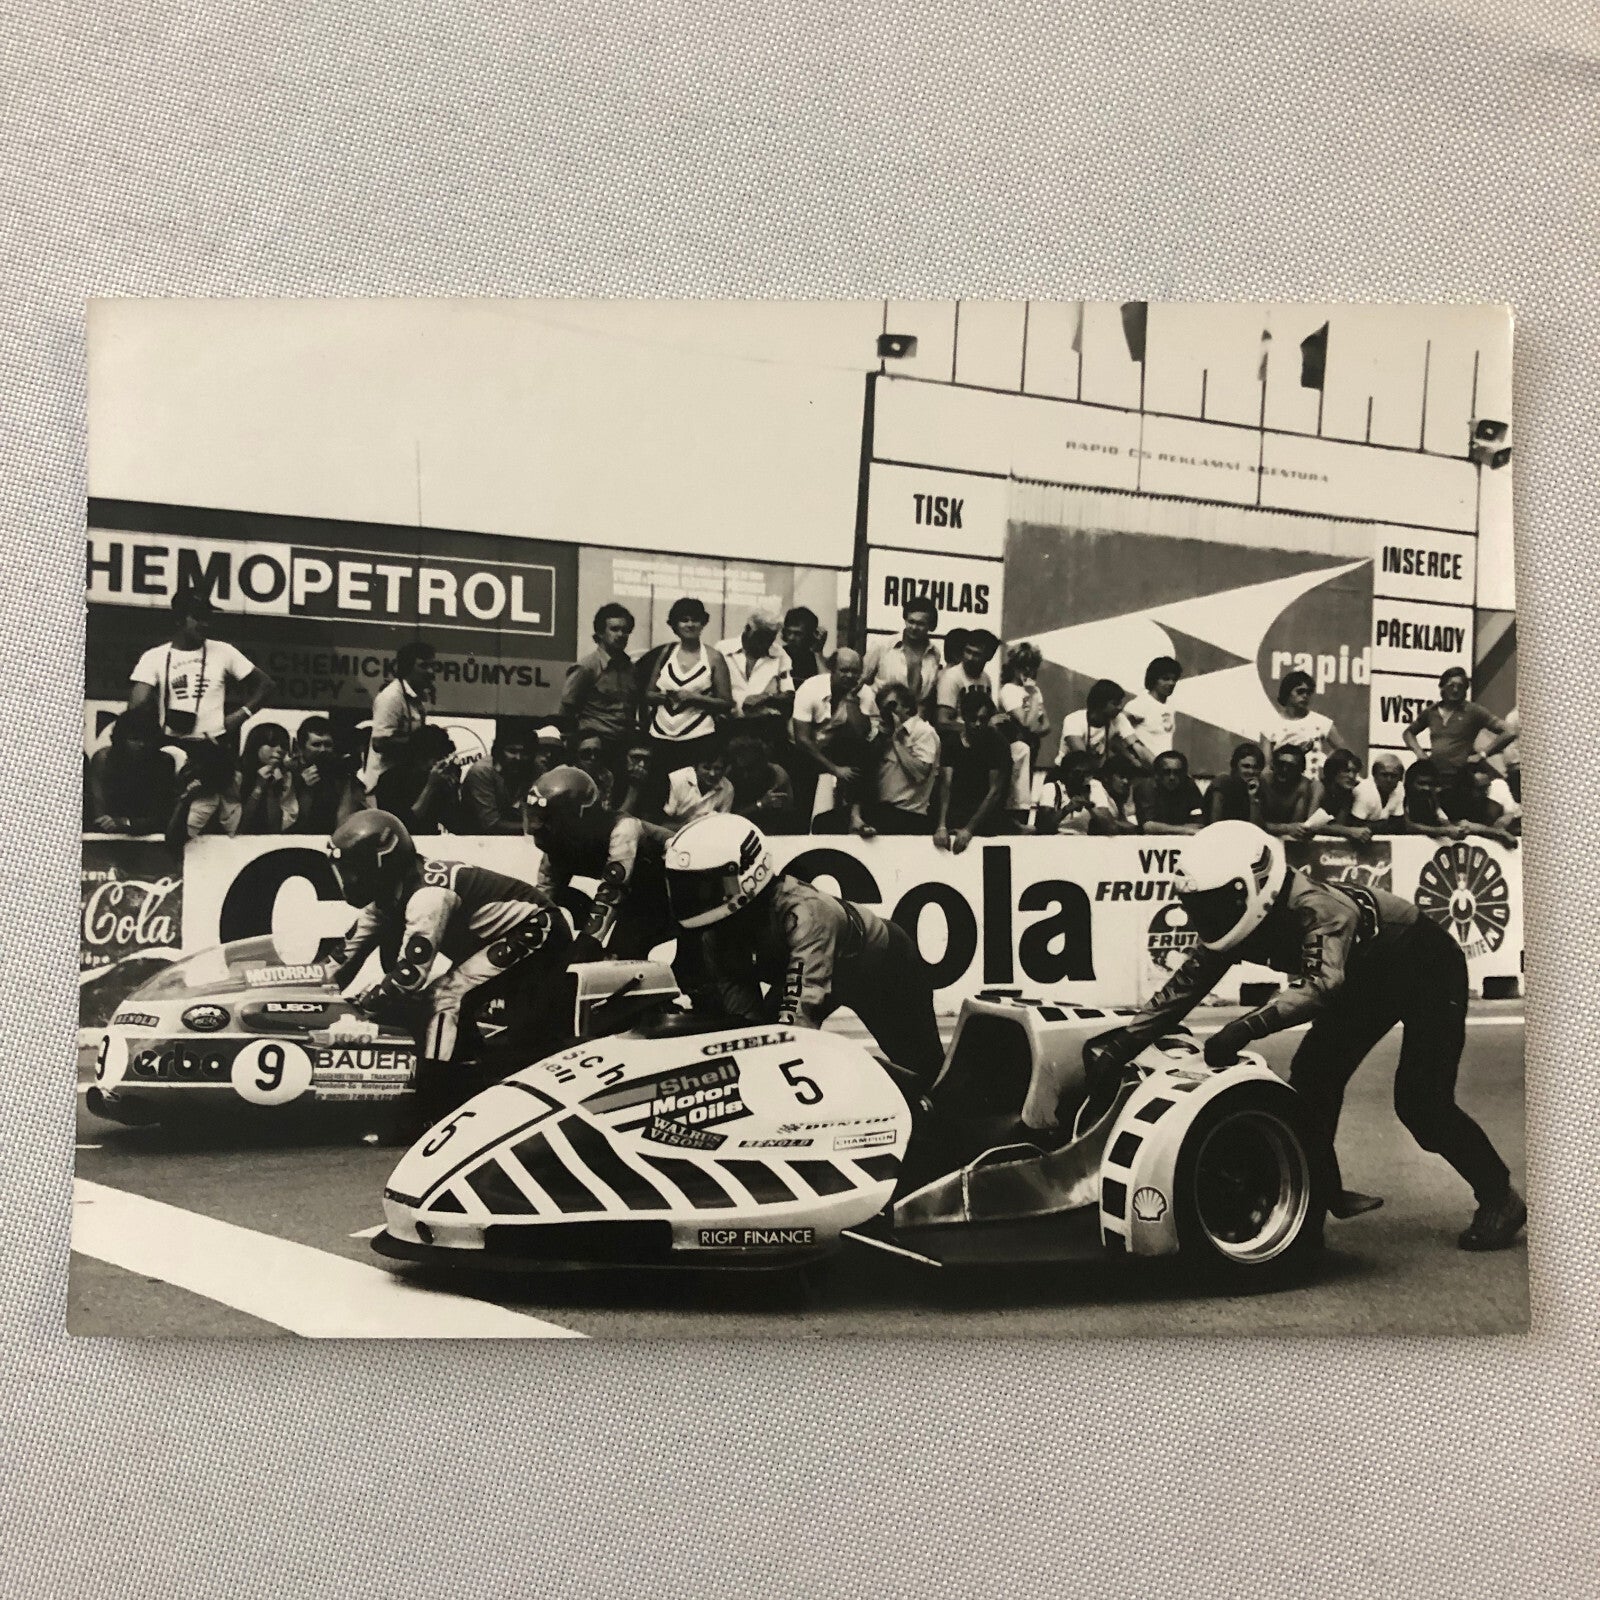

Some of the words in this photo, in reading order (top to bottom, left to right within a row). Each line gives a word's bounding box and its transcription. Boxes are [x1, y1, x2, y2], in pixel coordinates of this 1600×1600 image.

[913, 493, 964, 529] TISK
[1382, 545, 1463, 580] INSERCE
[884, 575, 990, 614] ROZHLAS
[1376, 618, 1466, 654] PŘEKLADY
[1271, 644, 1371, 695] rapid
[1380, 694, 1433, 724] VÝST
[85, 876, 183, 945] Cola
[246, 965, 325, 985] MOTORRAD
[267, 1002, 323, 1012] BUSCH
[133, 1042, 226, 1077] erbo
[315, 1049, 411, 1070] BAUER
[702, 1031, 796, 1056] CHELL
[255, 1043, 286, 1092] 9
[661, 1063, 737, 1096] Shell
[778, 1057, 824, 1105] 5
[651, 1082, 739, 1116] Motor
[688, 1100, 744, 1125] Oils
[422, 1111, 477, 1157] 5
[836, 1134, 895, 1147] CHAMPION
[701, 1230, 737, 1243] RIGP
[744, 1230, 812, 1244] FINANCE
